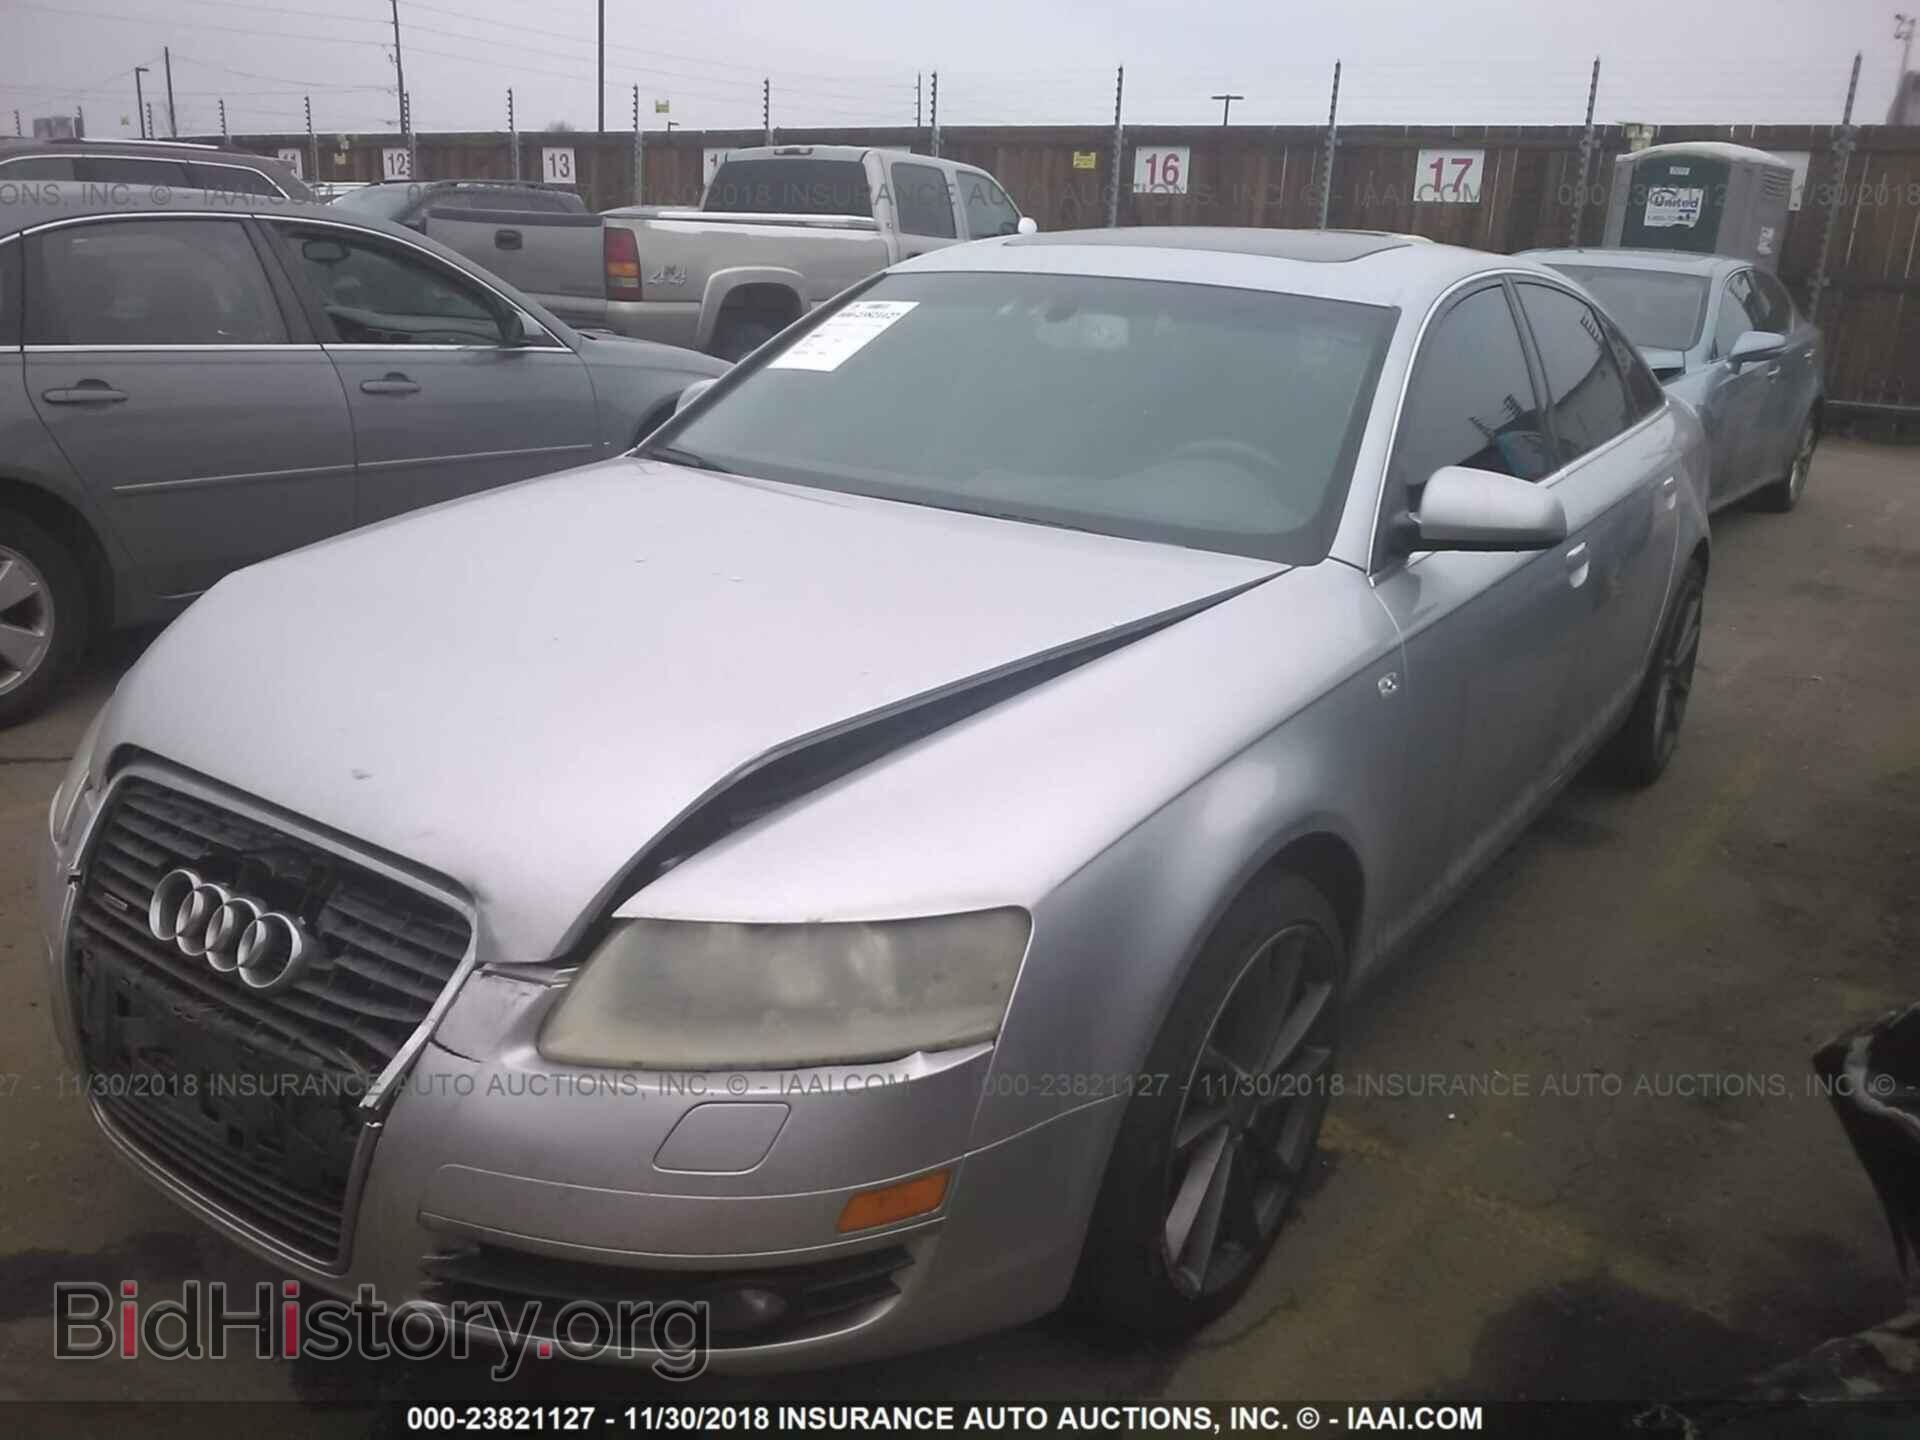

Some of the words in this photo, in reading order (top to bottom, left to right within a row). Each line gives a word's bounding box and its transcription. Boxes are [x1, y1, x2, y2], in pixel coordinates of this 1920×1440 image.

[388, 152, 406, 176] 12
[547, 151, 571, 179] 13
[1145, 153, 1180, 186] 16
[1429, 157, 1474, 193] 17
